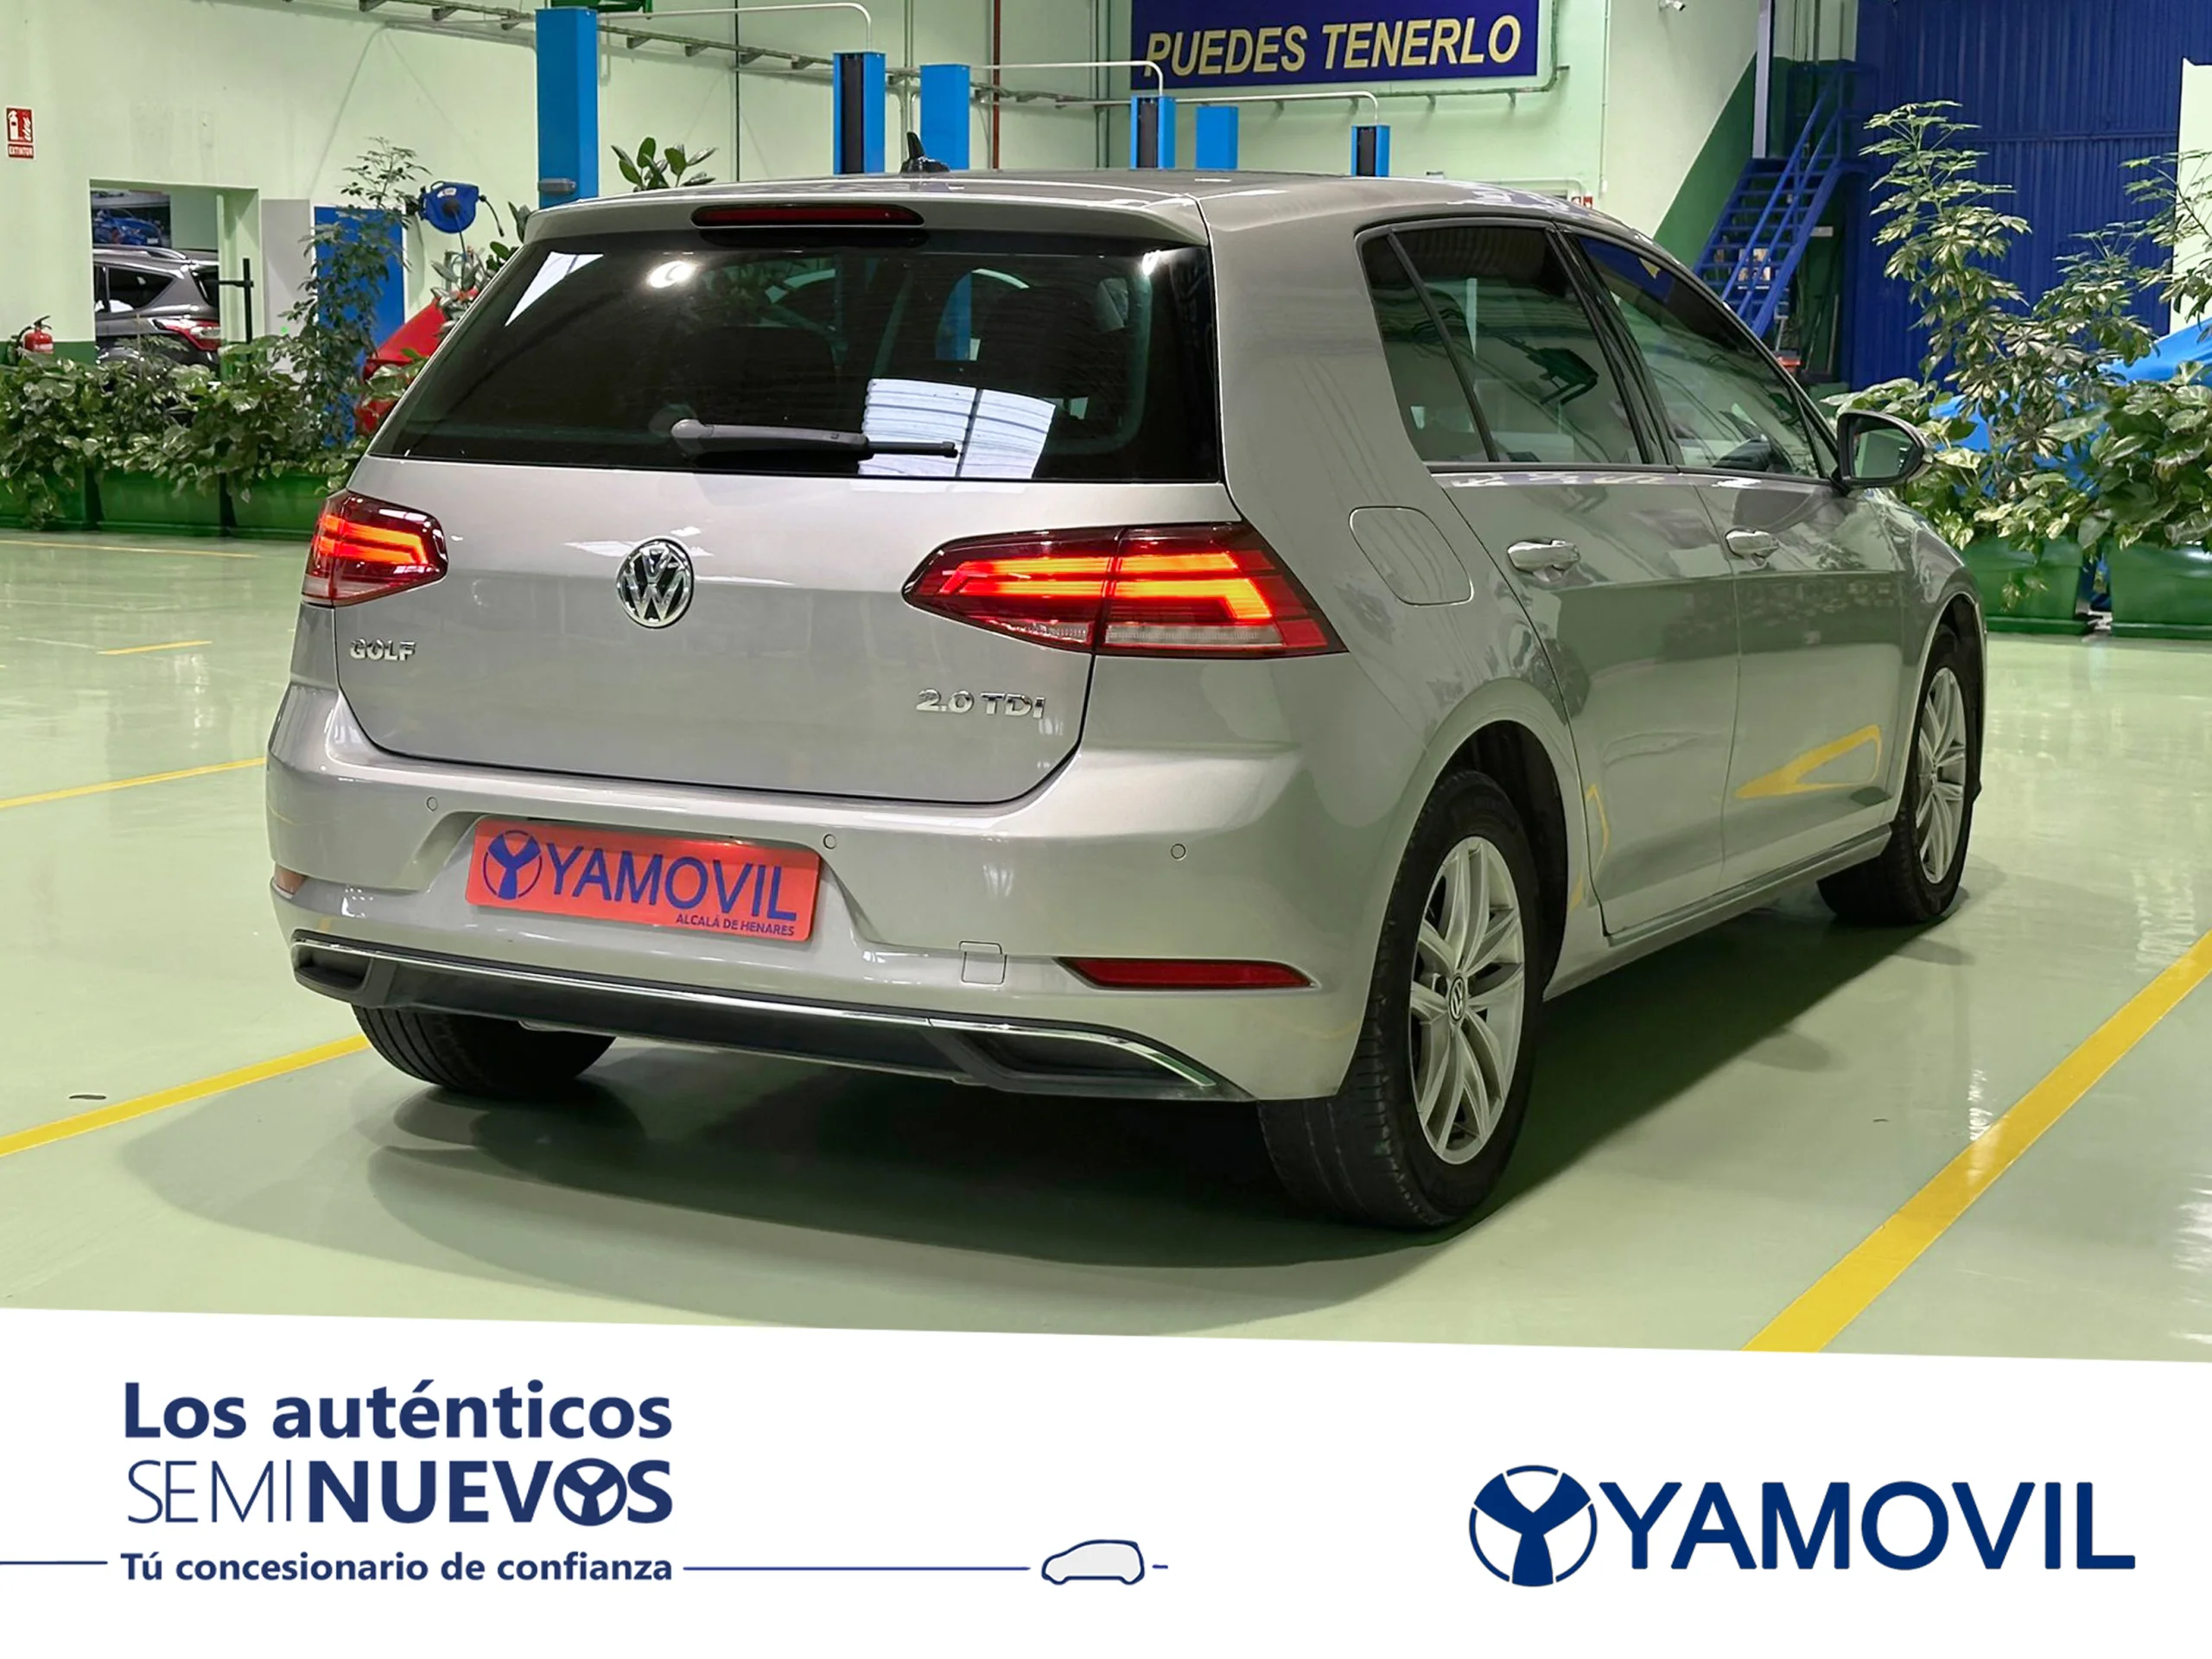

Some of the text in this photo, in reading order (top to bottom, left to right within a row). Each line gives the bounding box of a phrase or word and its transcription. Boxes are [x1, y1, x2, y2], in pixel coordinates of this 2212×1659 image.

[1143, 14, 1522, 78] PUEDES TENERLO
[349, 638, 416, 662] GOLF
[916, 688, 1046, 719] 2.0 TDI
[545, 842, 798, 922] YAMOVIL
[676, 912, 795, 937] ALCALÁ DE HENARES
